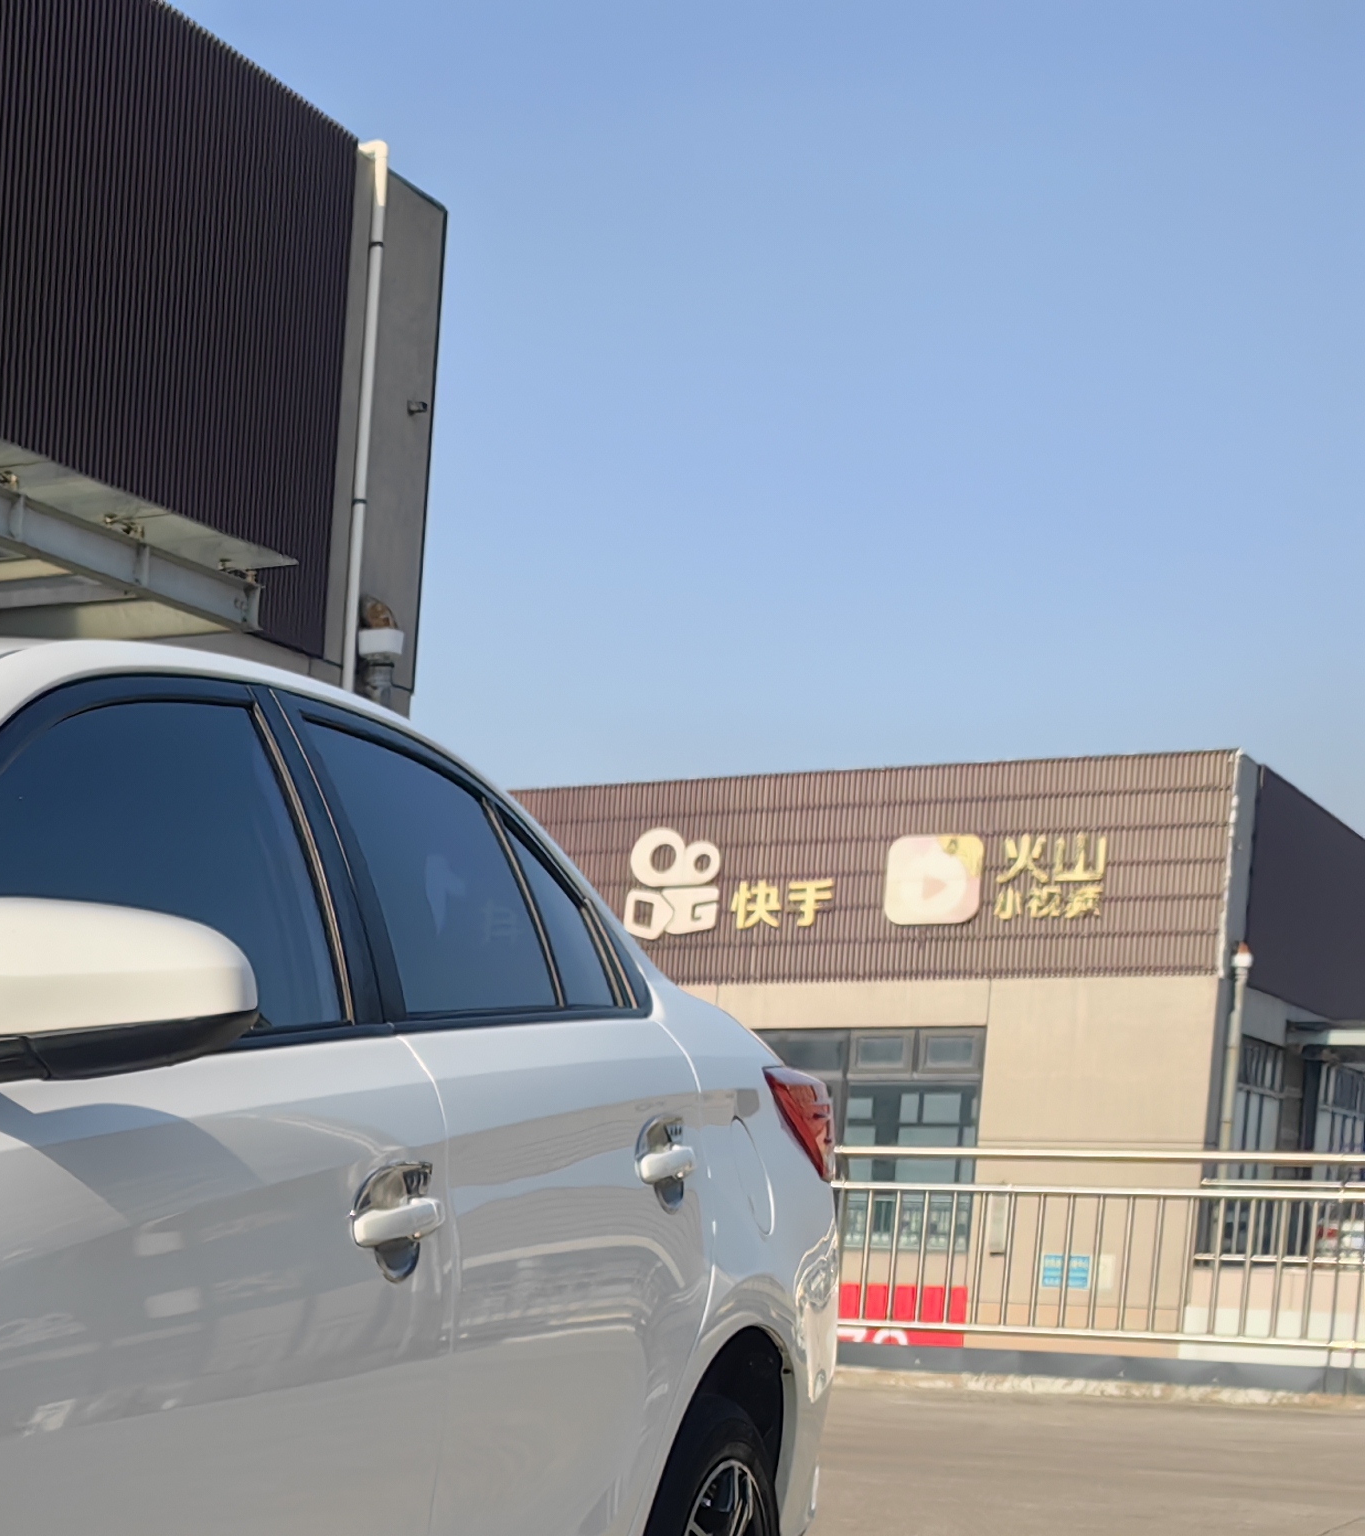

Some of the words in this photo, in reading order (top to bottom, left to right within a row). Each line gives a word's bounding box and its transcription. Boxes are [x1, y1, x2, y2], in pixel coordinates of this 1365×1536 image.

[995, 831, 1108, 884] 火山
[730, 877, 836, 930] 快手
[993, 884, 1105, 921] 小视频
